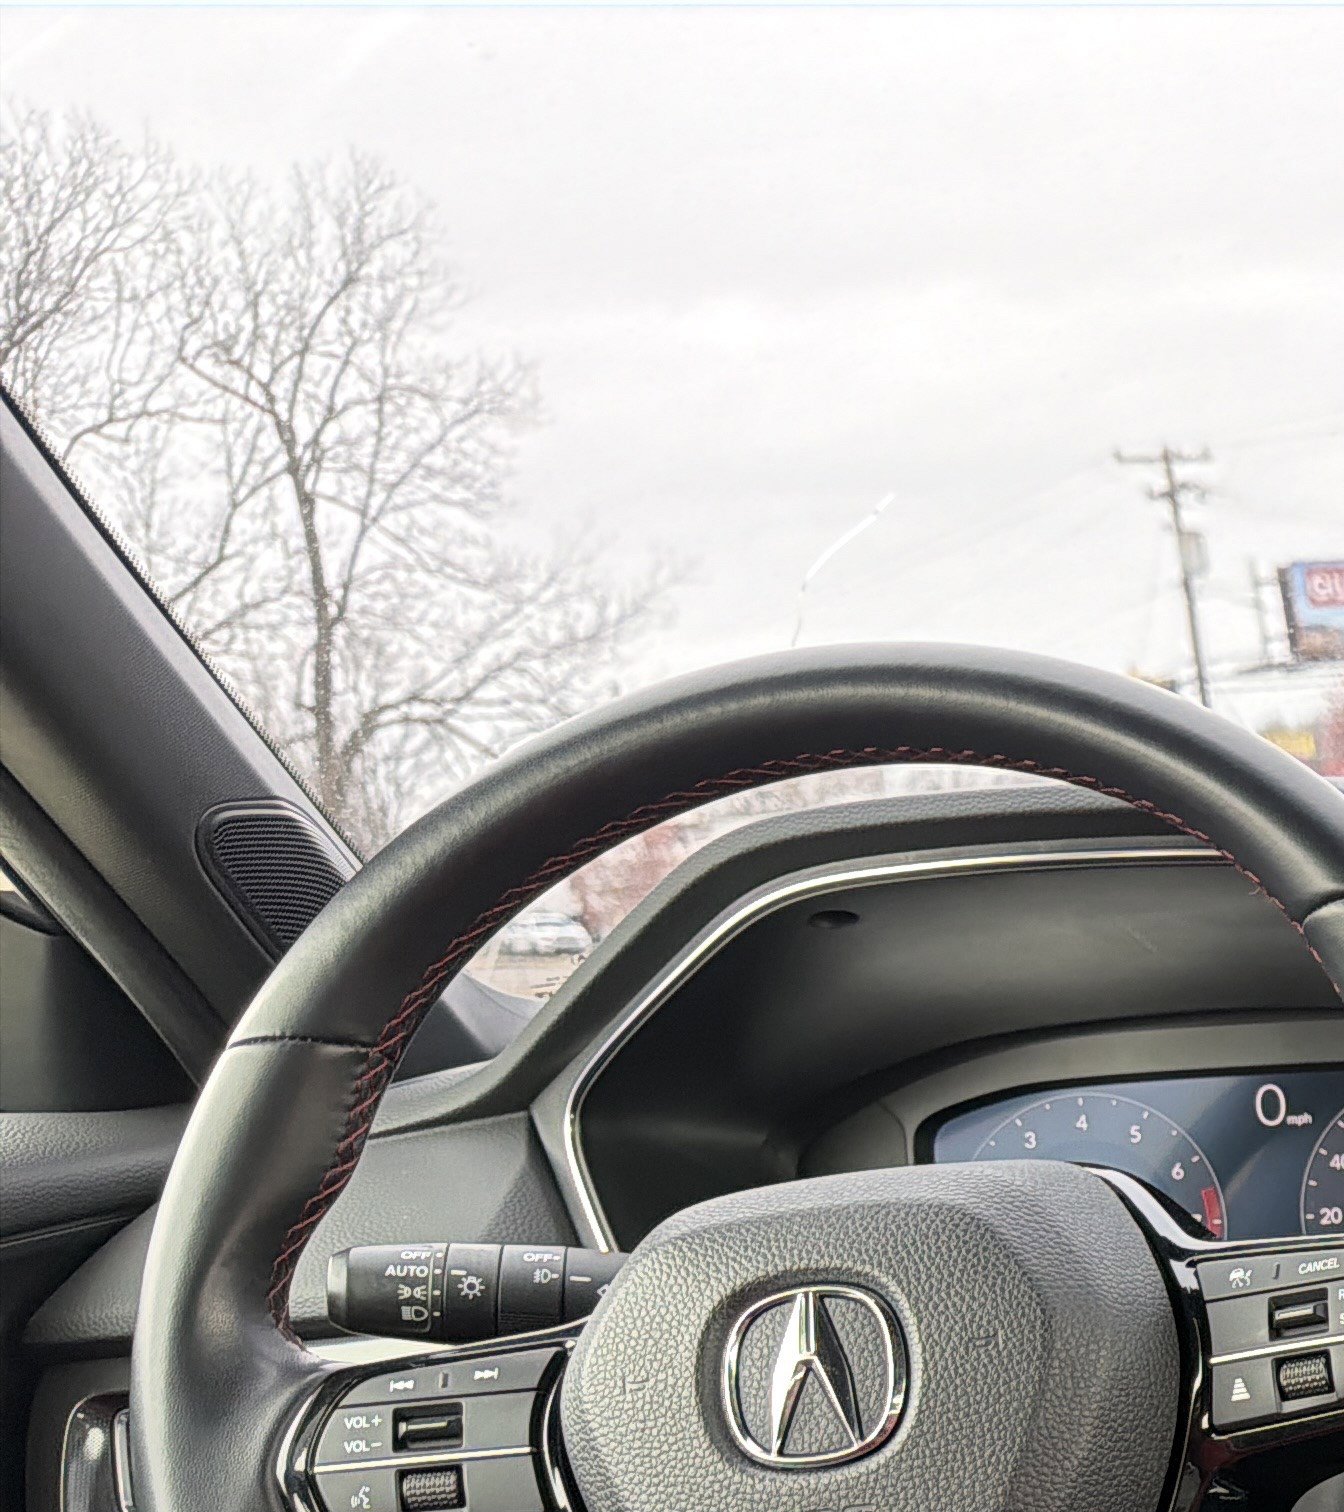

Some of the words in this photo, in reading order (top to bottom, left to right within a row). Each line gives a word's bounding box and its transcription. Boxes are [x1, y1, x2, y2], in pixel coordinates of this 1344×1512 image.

[1255, 1083, 1287, 1127] 0
[1286, 1112, 1313, 1127] mph
[1075, 1114, 1088, 1132] 4
[1024, 1131, 1037, 1149] 3
[1130, 1125, 1142, 1144] 5
[1171, 1162, 1185, 1181] 6
[1319, 1206, 1343, 1225] 20
[400, 1251, 431, 1260] OFF
[523, 1253, 553, 1263] OFF
[385, 1265, 429, 1277] AUTO
[1298, 1257, 1340, 1275] CANCEL
